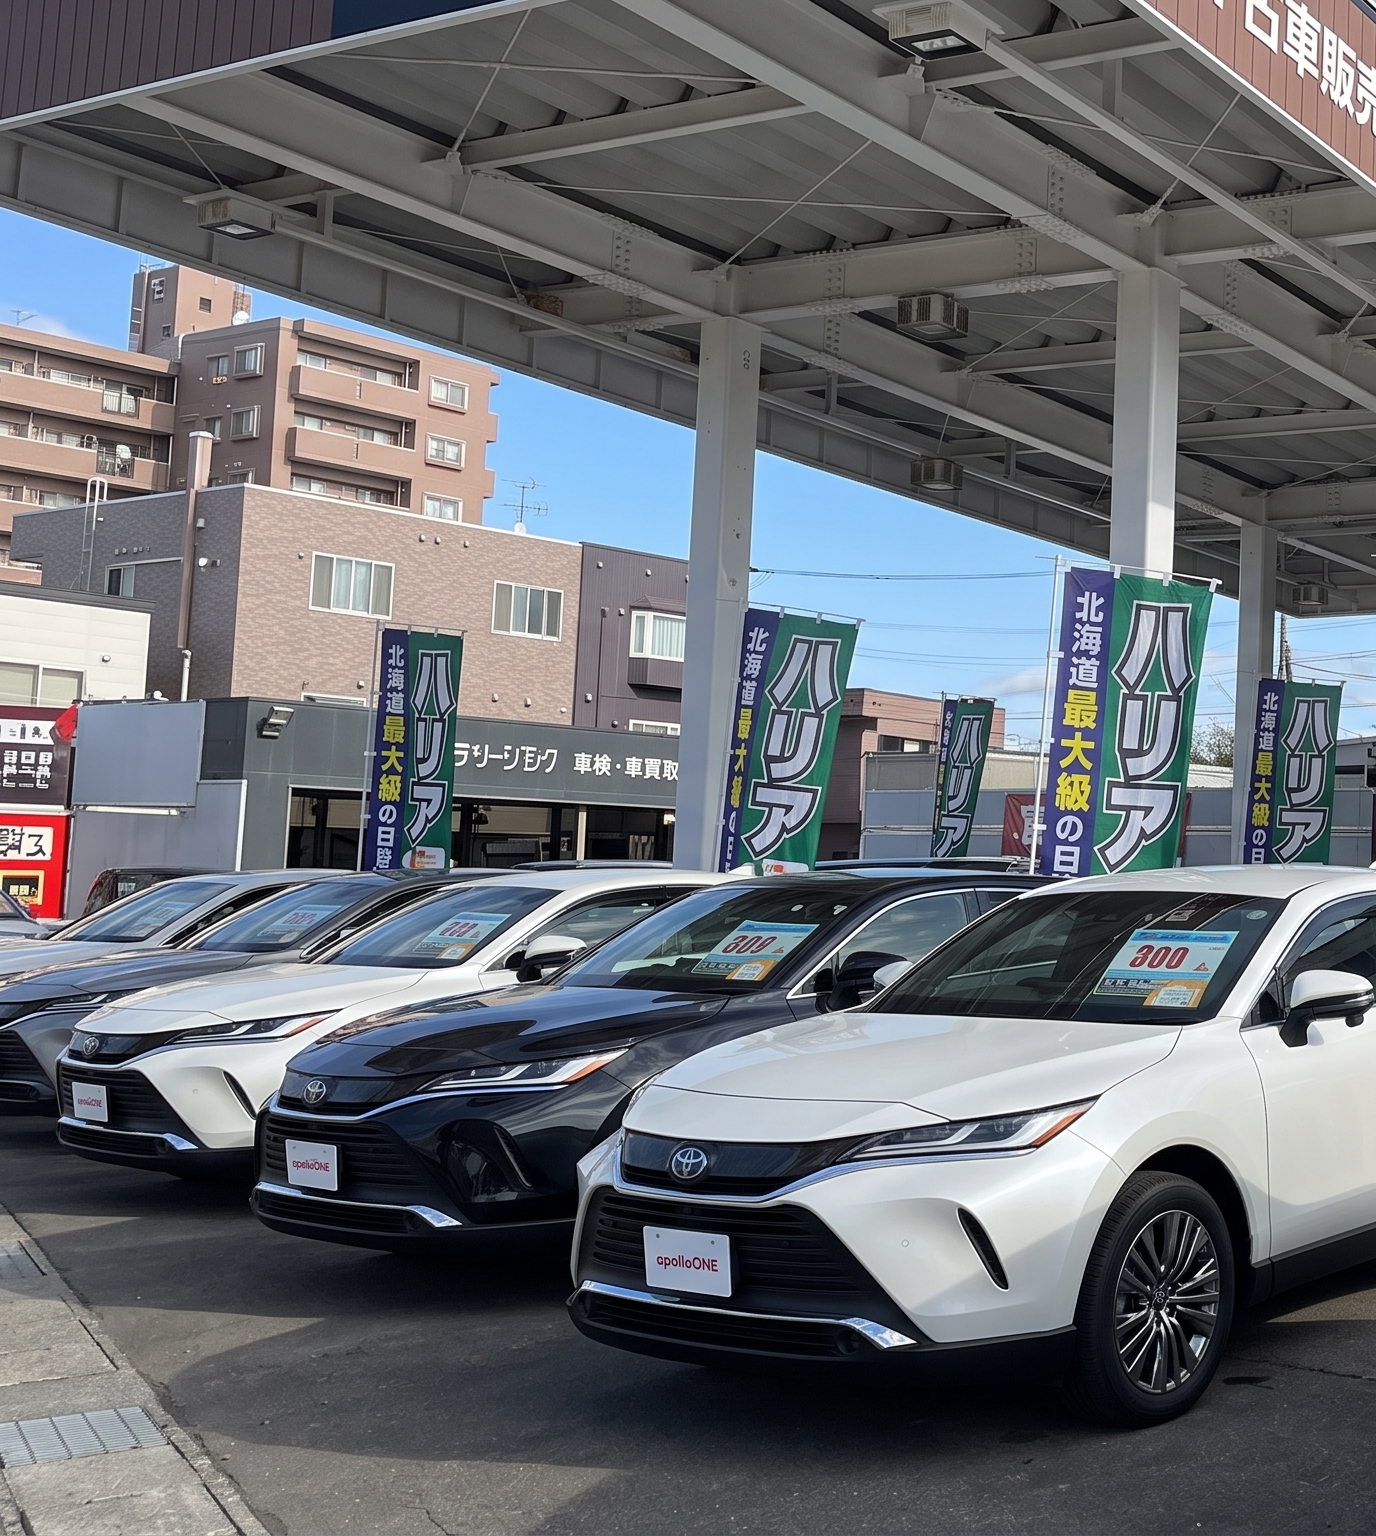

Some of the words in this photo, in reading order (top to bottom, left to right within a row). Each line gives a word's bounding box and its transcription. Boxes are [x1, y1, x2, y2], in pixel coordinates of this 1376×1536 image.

[404, 650, 456, 848] ハリア
[573, 752, 679, 781] 車検・車買取
[740, 634, 842, 861] ハリア
[1051, 591, 1105, 878] 北海道最大級の日
